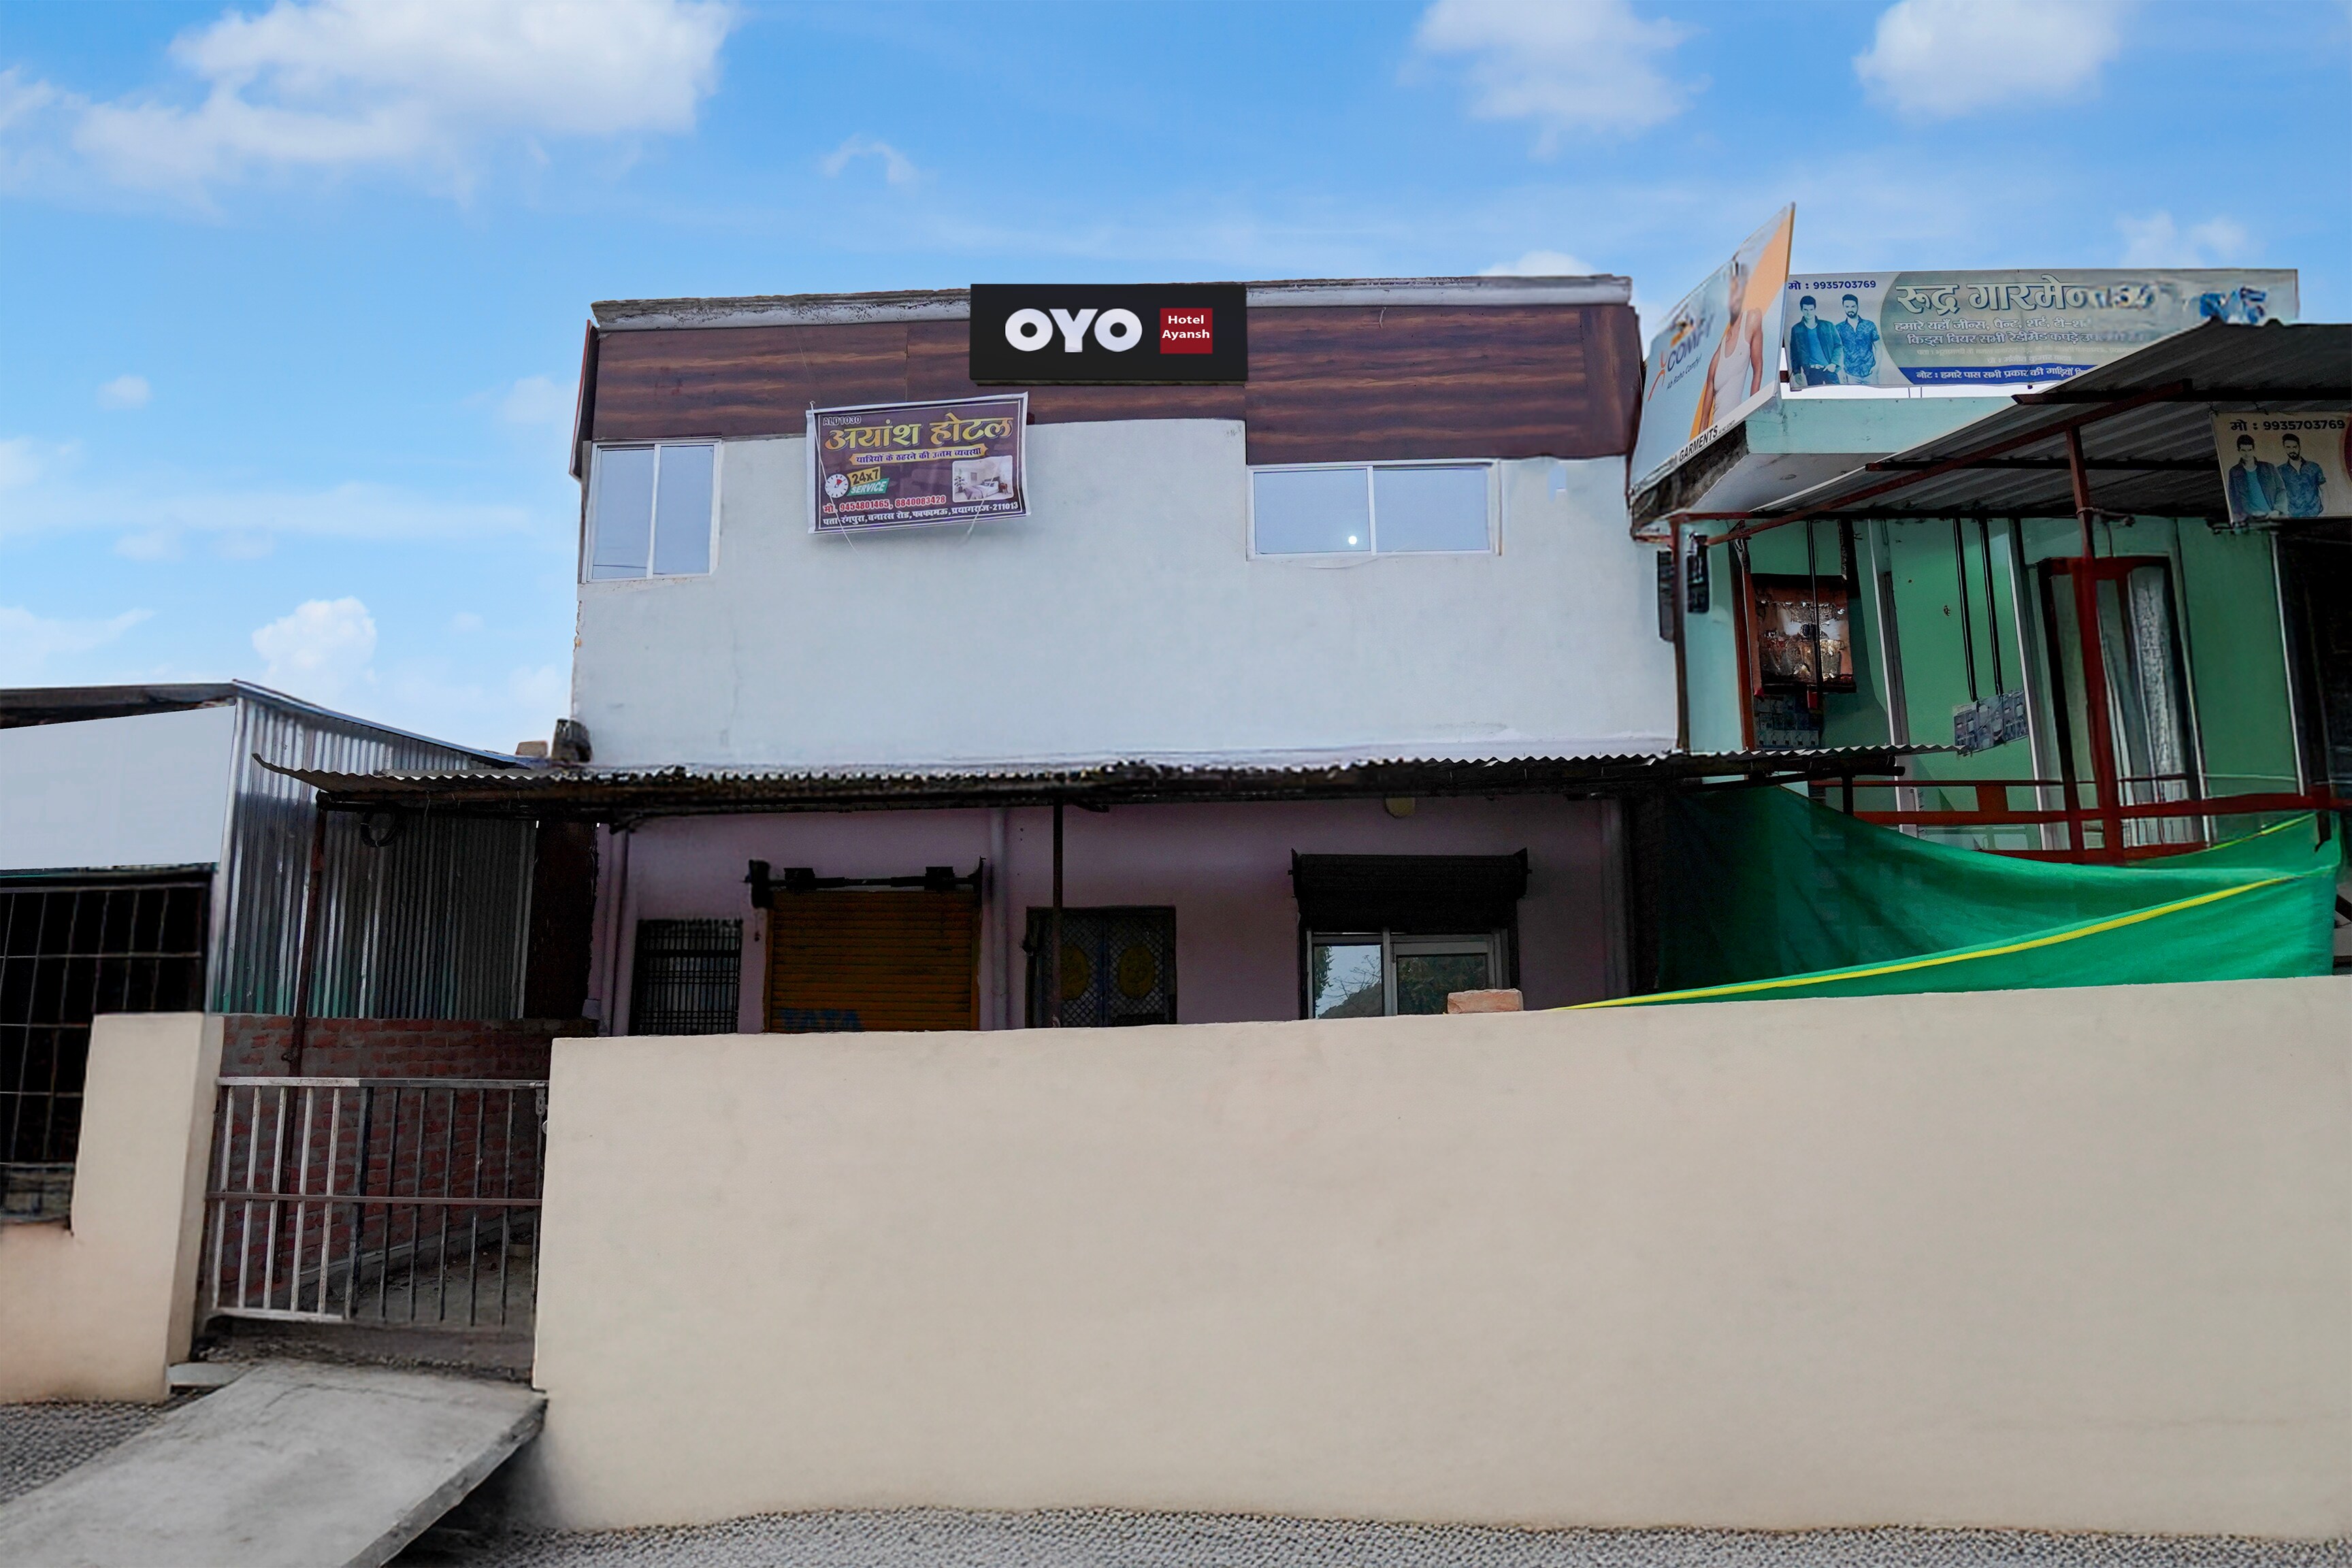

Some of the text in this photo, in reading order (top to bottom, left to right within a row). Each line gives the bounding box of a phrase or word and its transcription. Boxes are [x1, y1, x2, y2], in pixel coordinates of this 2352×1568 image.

[1813, 280, 1877, 291] 9935703769
[1168, 315, 1205, 325] Hotel
[1894, 319, 1925, 331] हमारे
[1005, 308, 1143, 353] OYO
[1162, 329, 1210, 340] Ayansh
[1978, 331, 2006, 344] सभी
[2006, 331, 2048, 342] रेडीमेड
[1940, 370, 1962, 379] हमारे
[1982, 369, 2002, 378] सभी
[2029, 367, 2044, 376] की
[823, 415, 862, 426] ALD1030
[2263, 419, 2345, 430] 9935703769
[824, 412, 1013, 451] अयांश होटल
[1679, 425, 1718, 461] GARMENTS
[886, 453, 894, 461] के
[919, 450, 930, 459] की
[851, 469, 879, 485] 24x7
[851, 481, 887, 494] SERVICE
[895, 495, 946, 508] 8840083428
